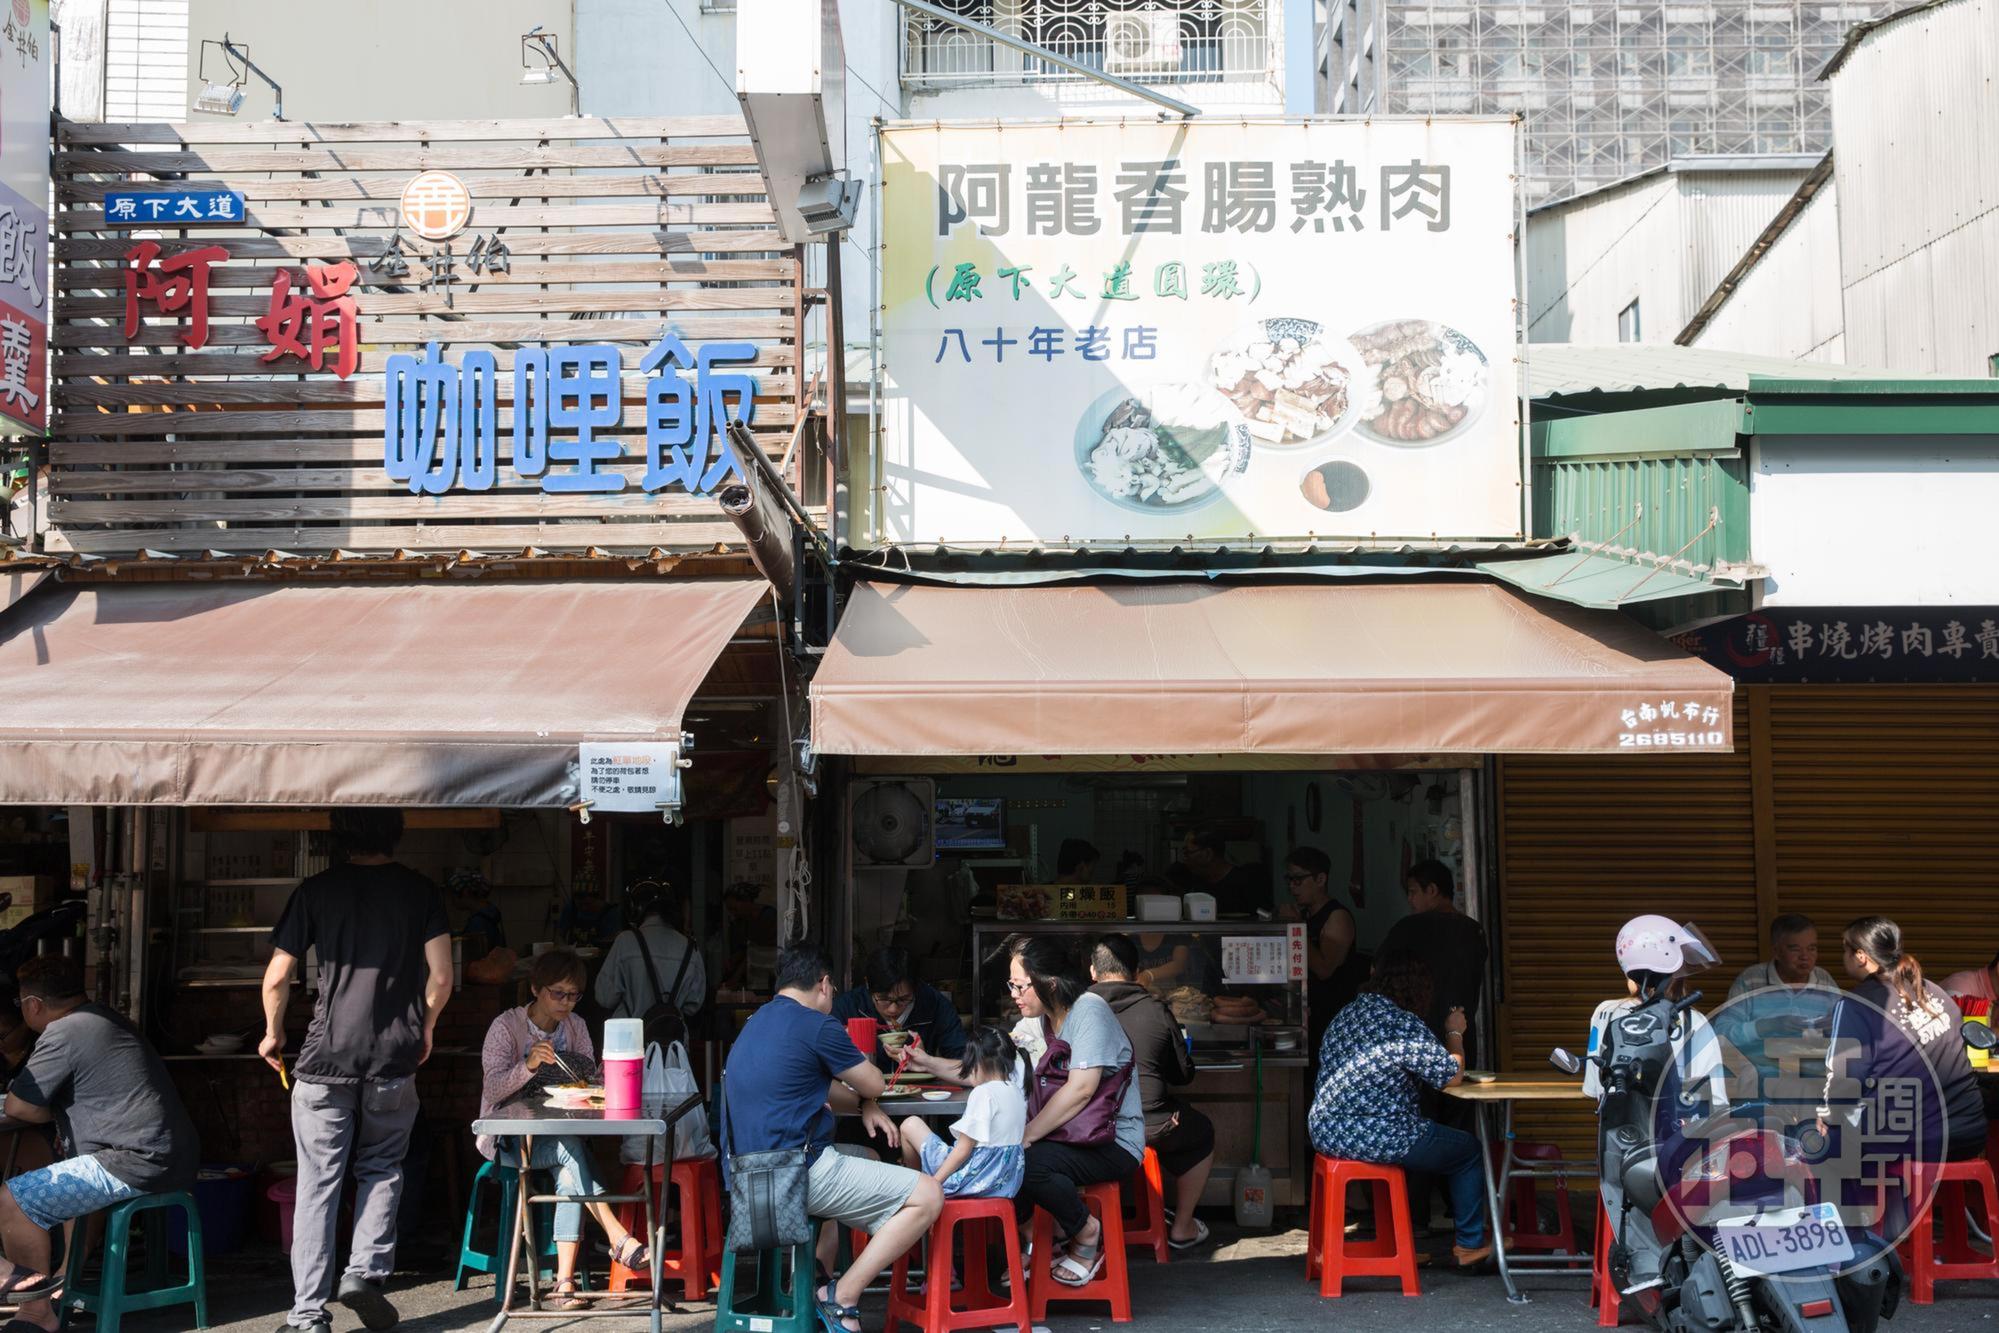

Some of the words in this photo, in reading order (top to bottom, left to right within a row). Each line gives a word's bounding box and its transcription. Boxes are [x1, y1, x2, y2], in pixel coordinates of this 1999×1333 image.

[108, 194, 237, 220] 原下大道
[938, 158, 1452, 238] 阿龍香腸熟肉
[123, 240, 360, 381] 阿娟
[934, 326, 1159, 364] 八十年老店
[383, 332, 759, 494] 咖哩飯
[1787, 620, 1999, 661] 串燒烤肉專賣
[1619, 700, 1720, 729] 台南帆布行
[1618, 732, 1724, 747] 2685110
[1291, 926, 1304, 977] 請先付款
